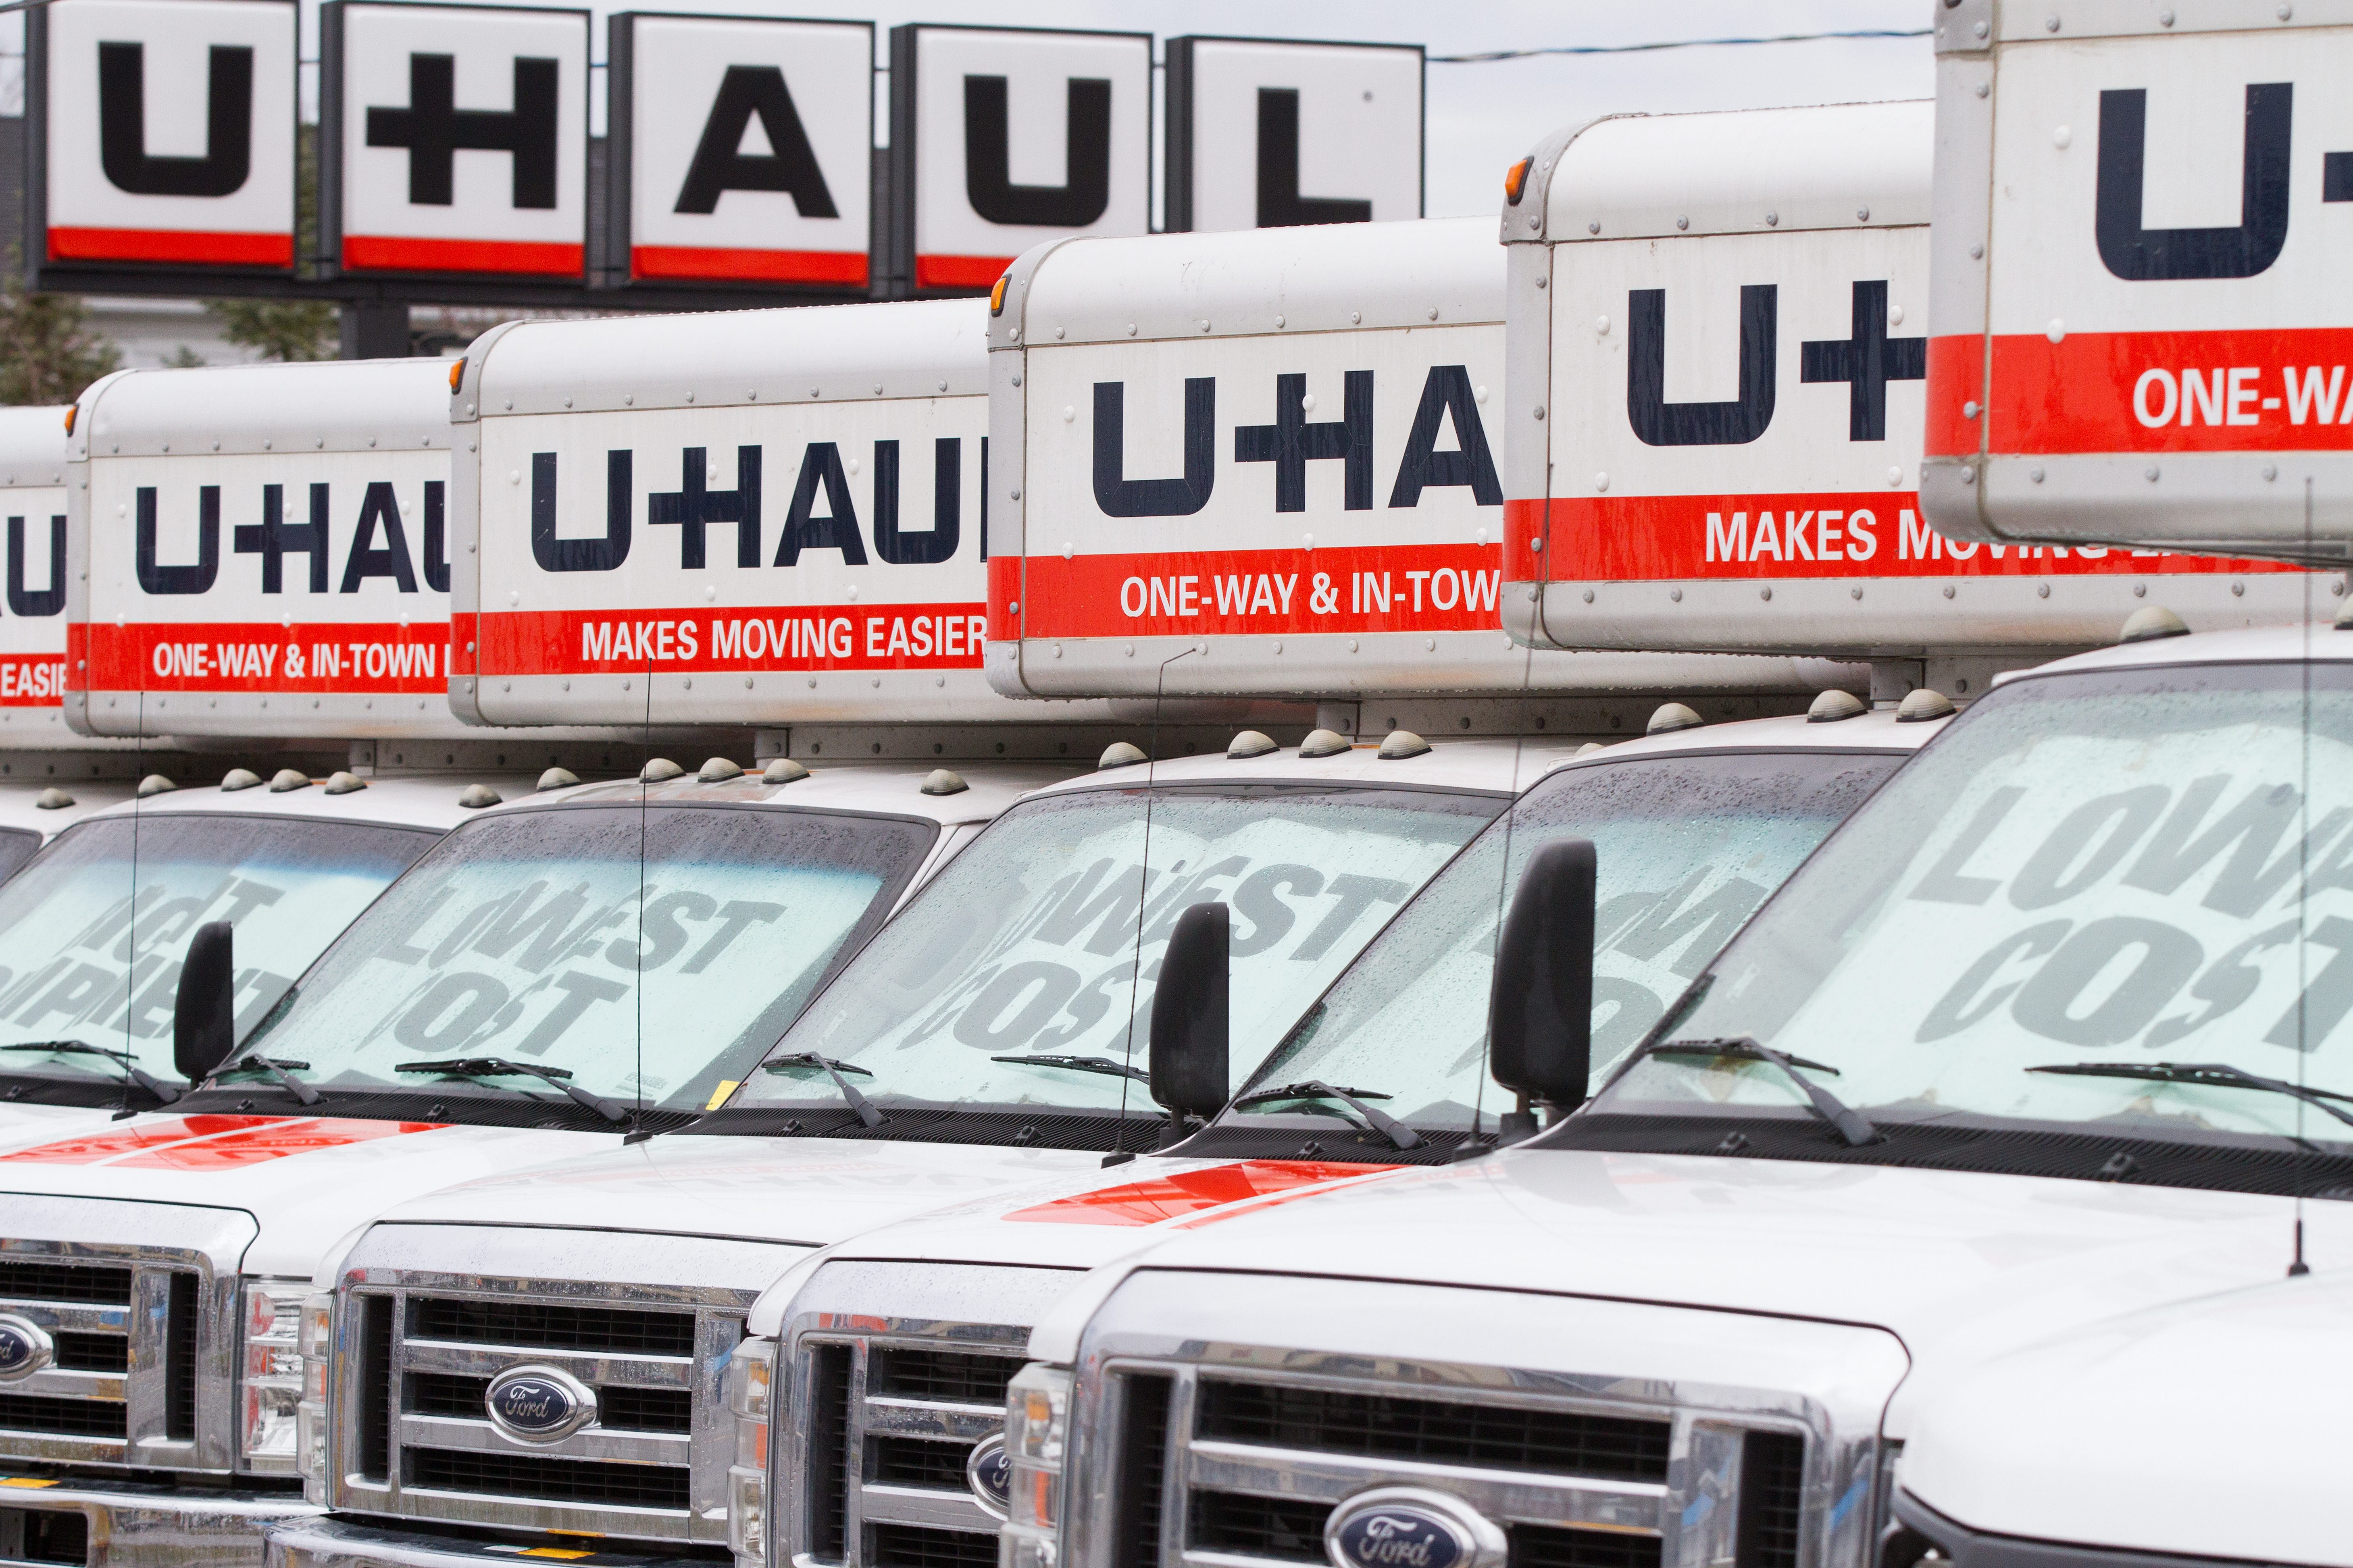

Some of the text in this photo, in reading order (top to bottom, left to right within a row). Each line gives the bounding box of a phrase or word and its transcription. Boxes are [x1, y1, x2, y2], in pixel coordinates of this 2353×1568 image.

[98, 40, 1372, 228] U-HAUL
[1093, 365, 1503, 518] U-HA
[531, 437, 987, 572] U-HAU
[1705, 509, 1877, 562] MAKES
[1120, 573, 1299, 618] ONE-WAY
[1309, 573, 1339, 614] &
[153, 642, 278, 677] ONE-WAY
[285, 643, 305, 678] &
[312, 643, 435, 677] IN-TOWN
[582, 616, 987, 661] MAKES MOVING EASIER
[505, 1385, 552, 1418] Ford
[1358, 1516, 1435, 1567] Ford
